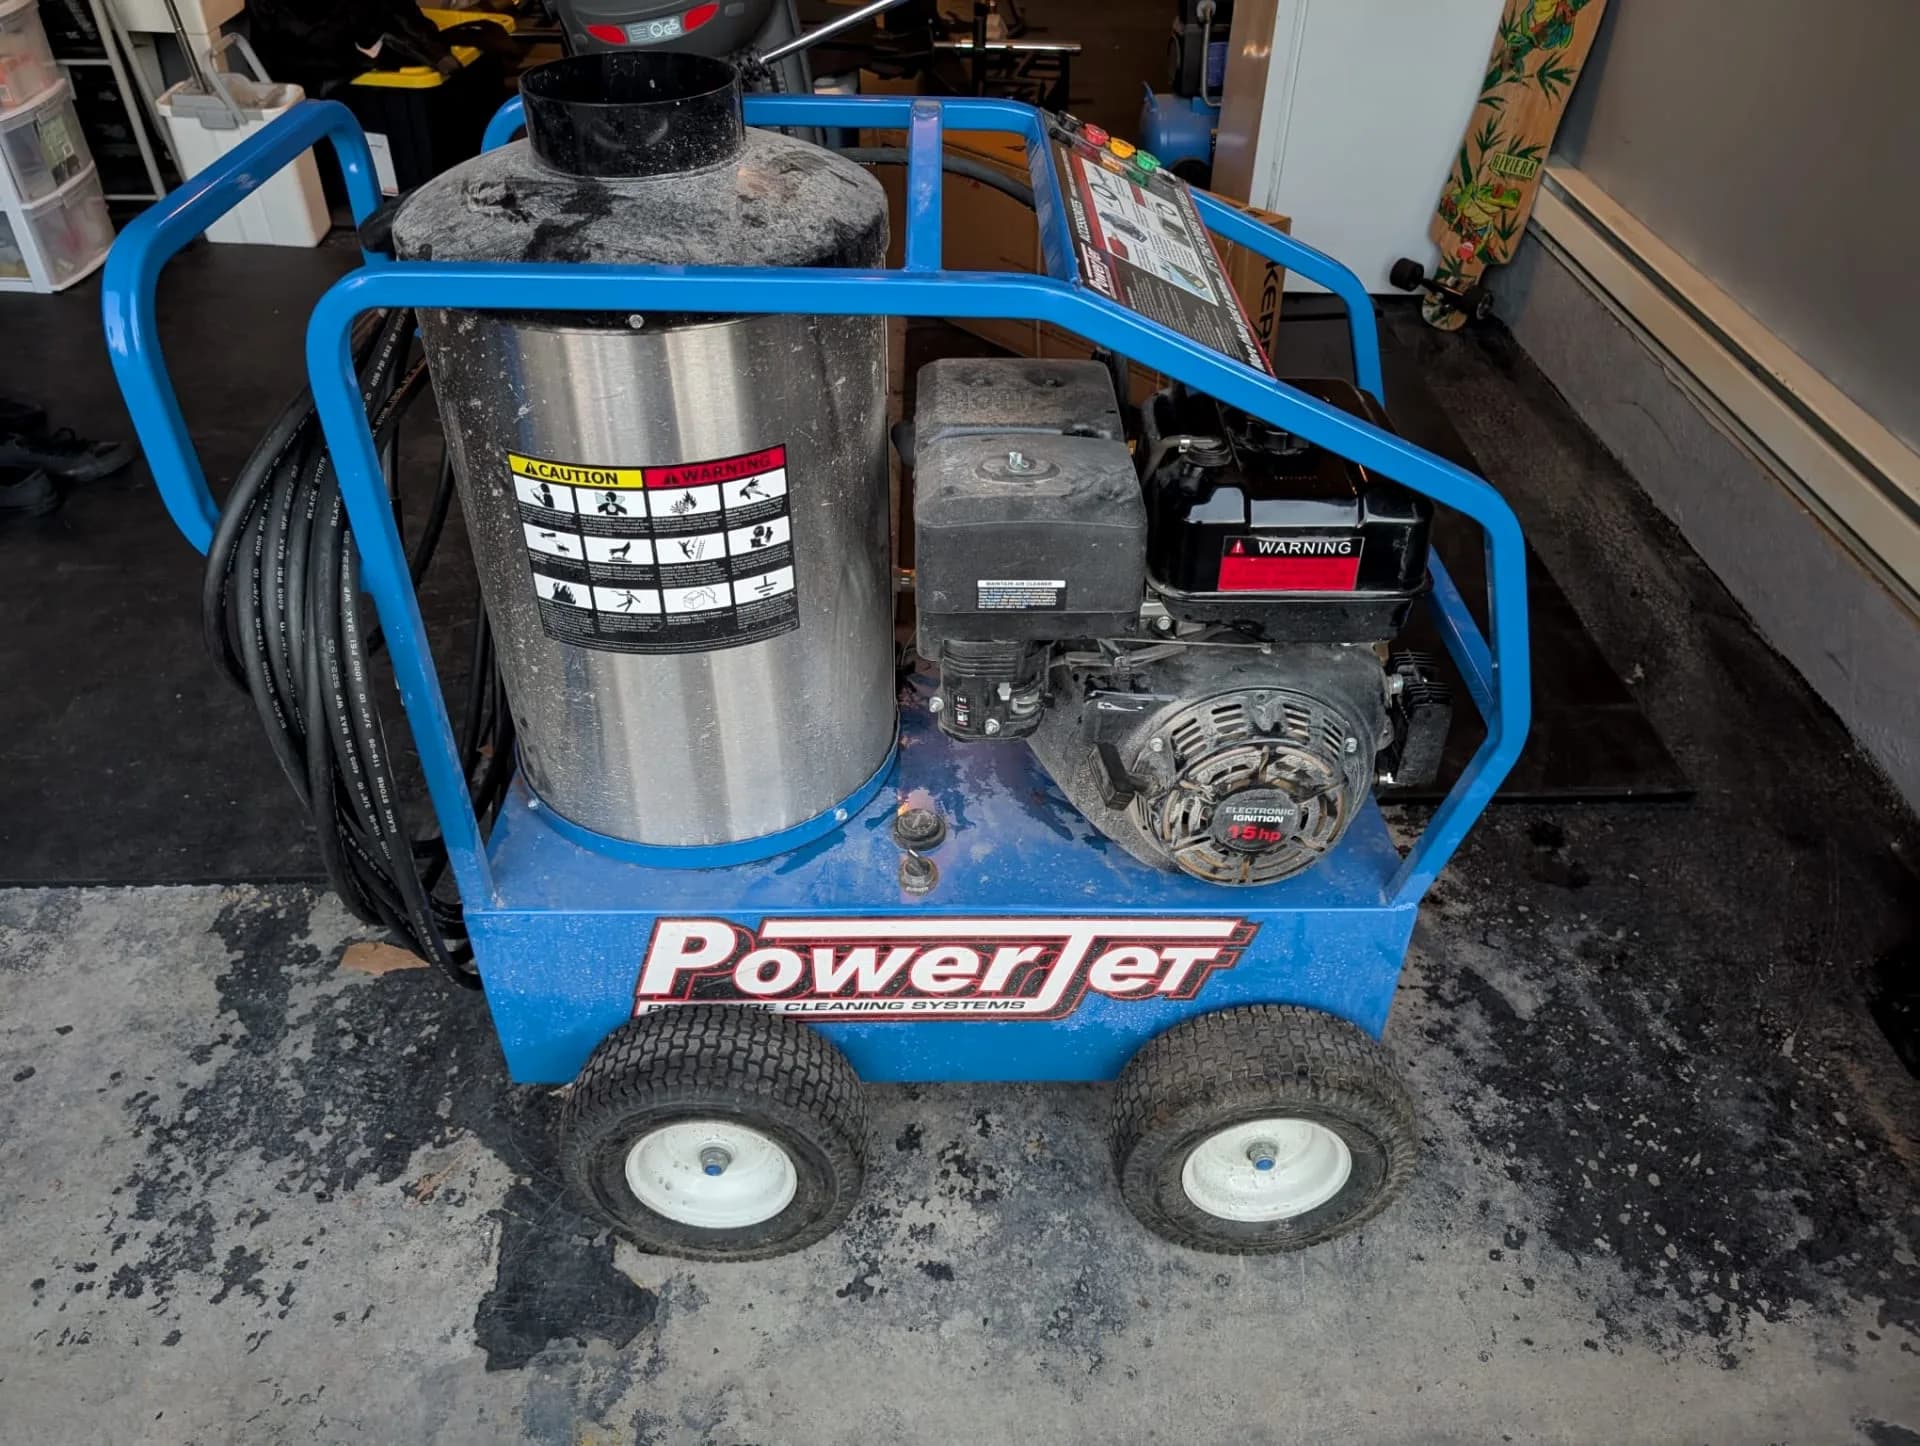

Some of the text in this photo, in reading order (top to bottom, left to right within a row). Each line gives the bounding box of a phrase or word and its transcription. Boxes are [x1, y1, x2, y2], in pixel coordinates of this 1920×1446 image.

[1493, 154, 1535, 177] RIVIERA
[538, 463, 619, 485] CAUTION
[680, 454, 771, 482] WARNING
[306, 489, 318, 519] BLACK
[330, 496, 342, 527] BLACK
[277, 538, 286, 560] MAX
[1258, 541, 1352, 555] WARNING
[343, 586, 351, 602] WP
[345, 610, 355, 632] MAX
[350, 639, 358, 655] PSI
[261, 661, 275, 694] STORM
[353, 661, 362, 681] 4000
[335, 694, 345, 709] WP
[272, 699, 287, 729] BLACK
[339, 715, 350, 735] MAX
[345, 739, 353, 754] PSI
[377, 776, 389, 804] STORM
[385, 809, 397, 833] BLACK
[1225, 806, 1296, 816] ELECTRONIC
[1232, 814, 1285, 823] IGNITION
[784, 1003, 905, 1011] CLEANING
[911, 1001, 1026, 1010] SYSTEMS
